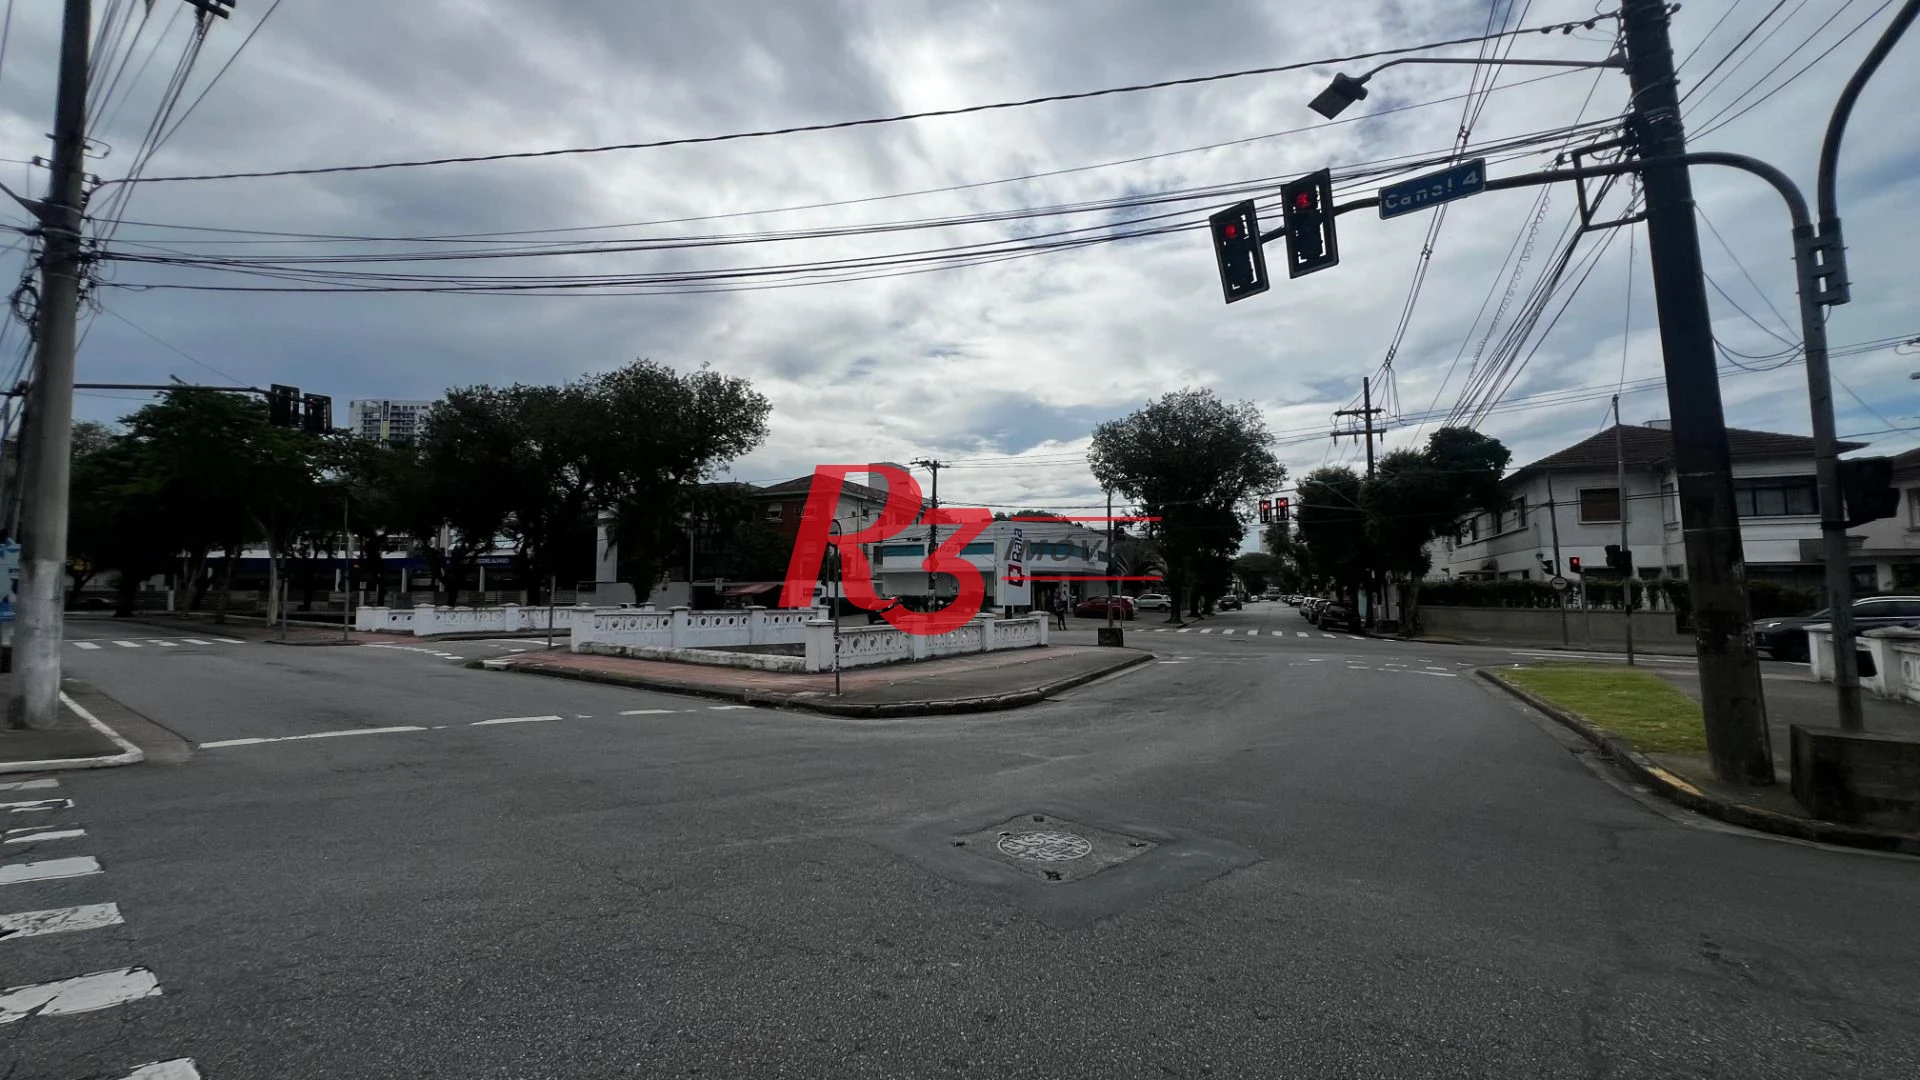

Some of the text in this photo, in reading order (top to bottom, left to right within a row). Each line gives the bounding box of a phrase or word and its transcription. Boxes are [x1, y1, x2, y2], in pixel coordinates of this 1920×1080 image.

[1385, 170, 1479, 209] Canal 4
[1011, 527, 1023, 563] Raia
